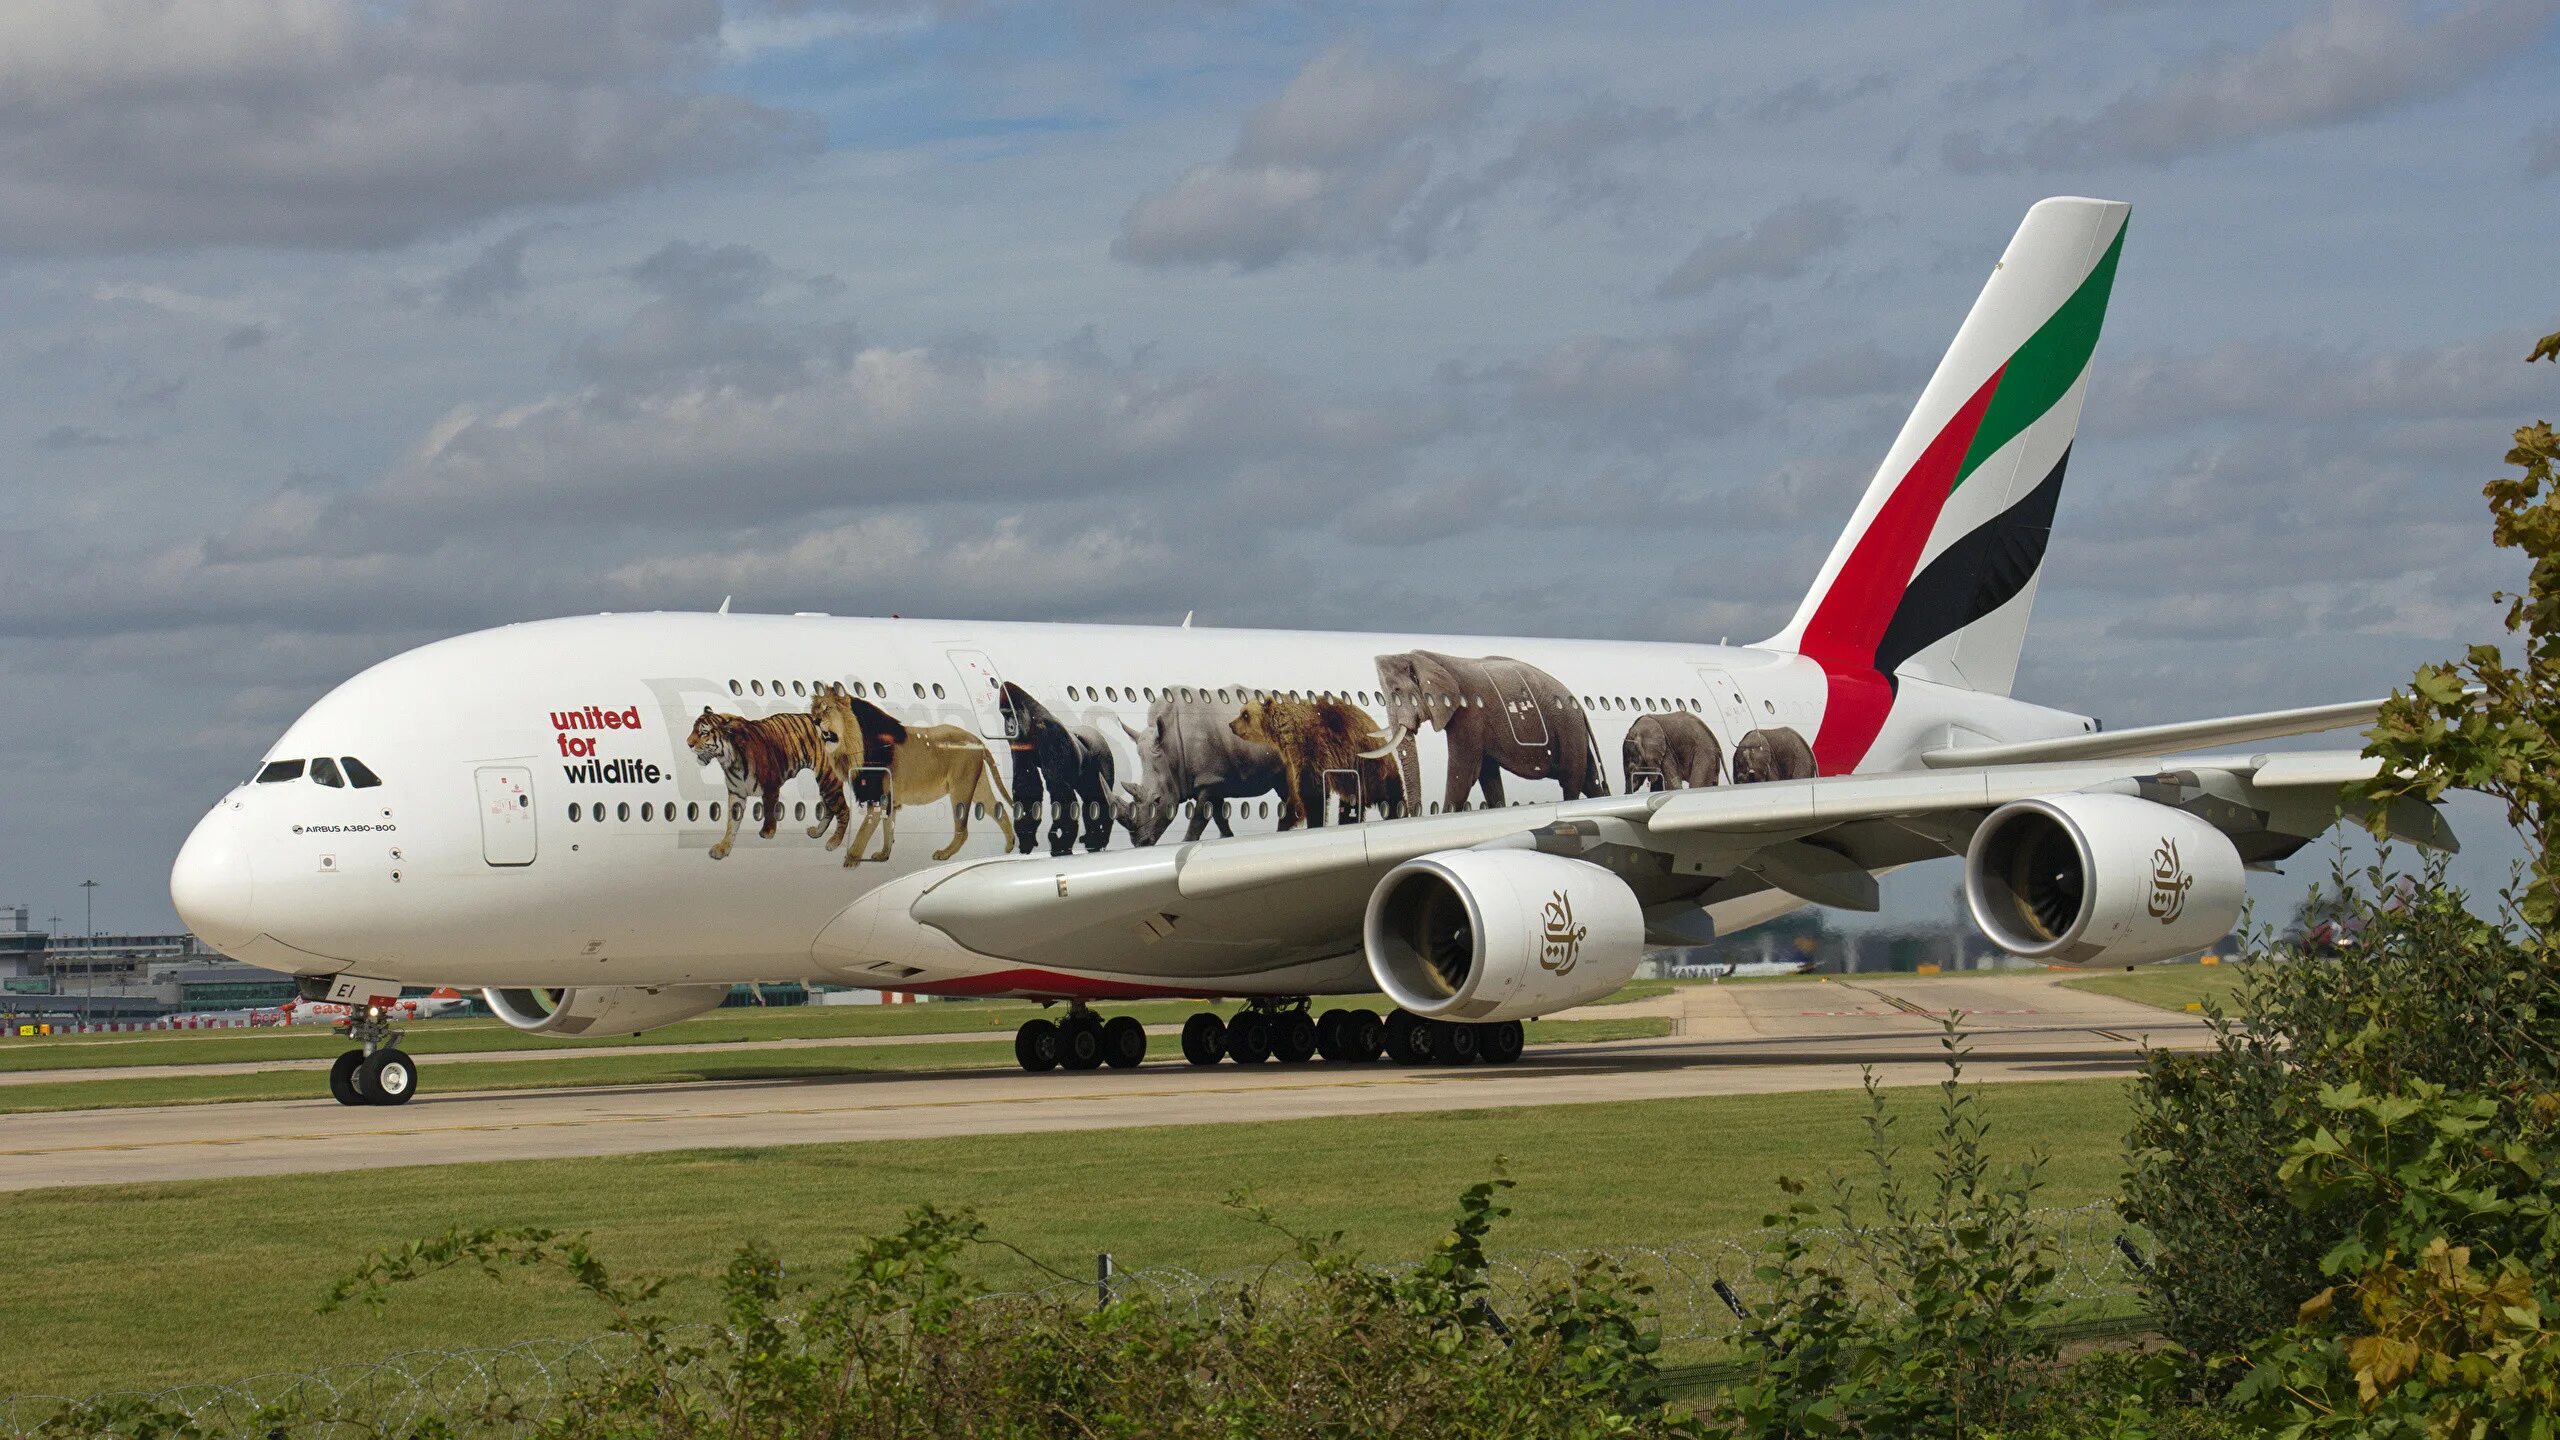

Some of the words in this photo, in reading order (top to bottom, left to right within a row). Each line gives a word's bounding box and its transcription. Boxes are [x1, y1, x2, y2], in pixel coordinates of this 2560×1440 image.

[550, 706, 642, 730] united
[557, 733, 597, 757] for
[305, 825, 341, 833] AIRBUS
[343, 824, 397, 832] A380-800
[335, 983, 356, 998] EI
